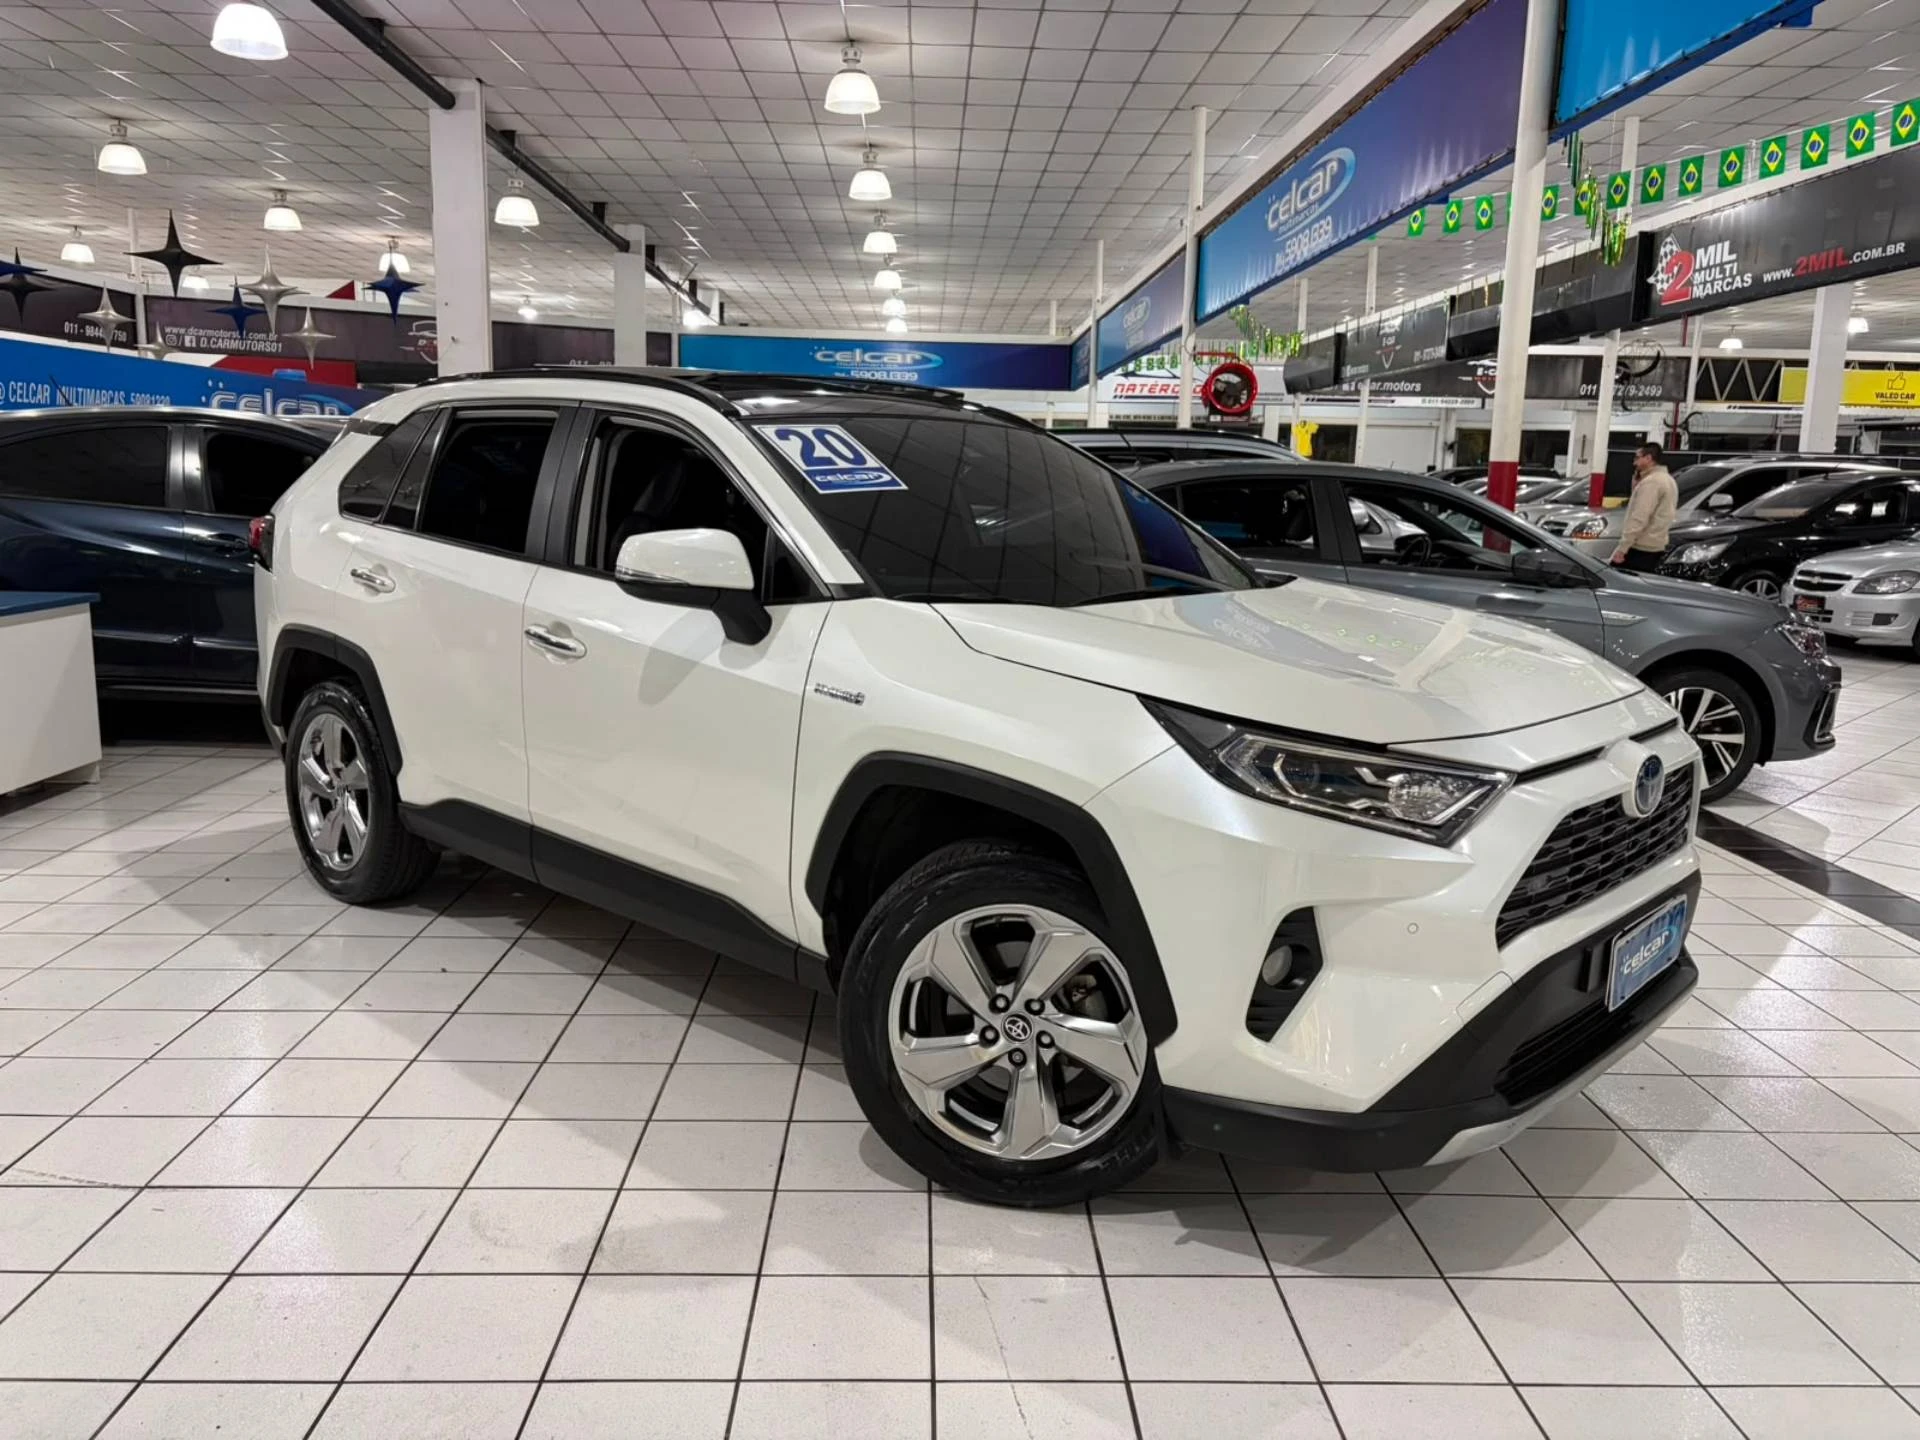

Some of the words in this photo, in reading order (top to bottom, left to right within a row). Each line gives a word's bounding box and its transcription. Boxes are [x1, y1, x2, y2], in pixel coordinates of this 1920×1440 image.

[1267, 160, 1338, 232] celcar
[1661, 250, 1695, 306] 2
[1695, 240, 1737, 270] MIL
[1692, 274, 1753, 299] MARCAS
[1693, 262, 1738, 284] MULTI
[816, 348, 922, 365] celcar
[9, 380, 50, 405] CELCAR
[775, 429, 867, 467] 20
[1624, 930, 1669, 975] celcar
